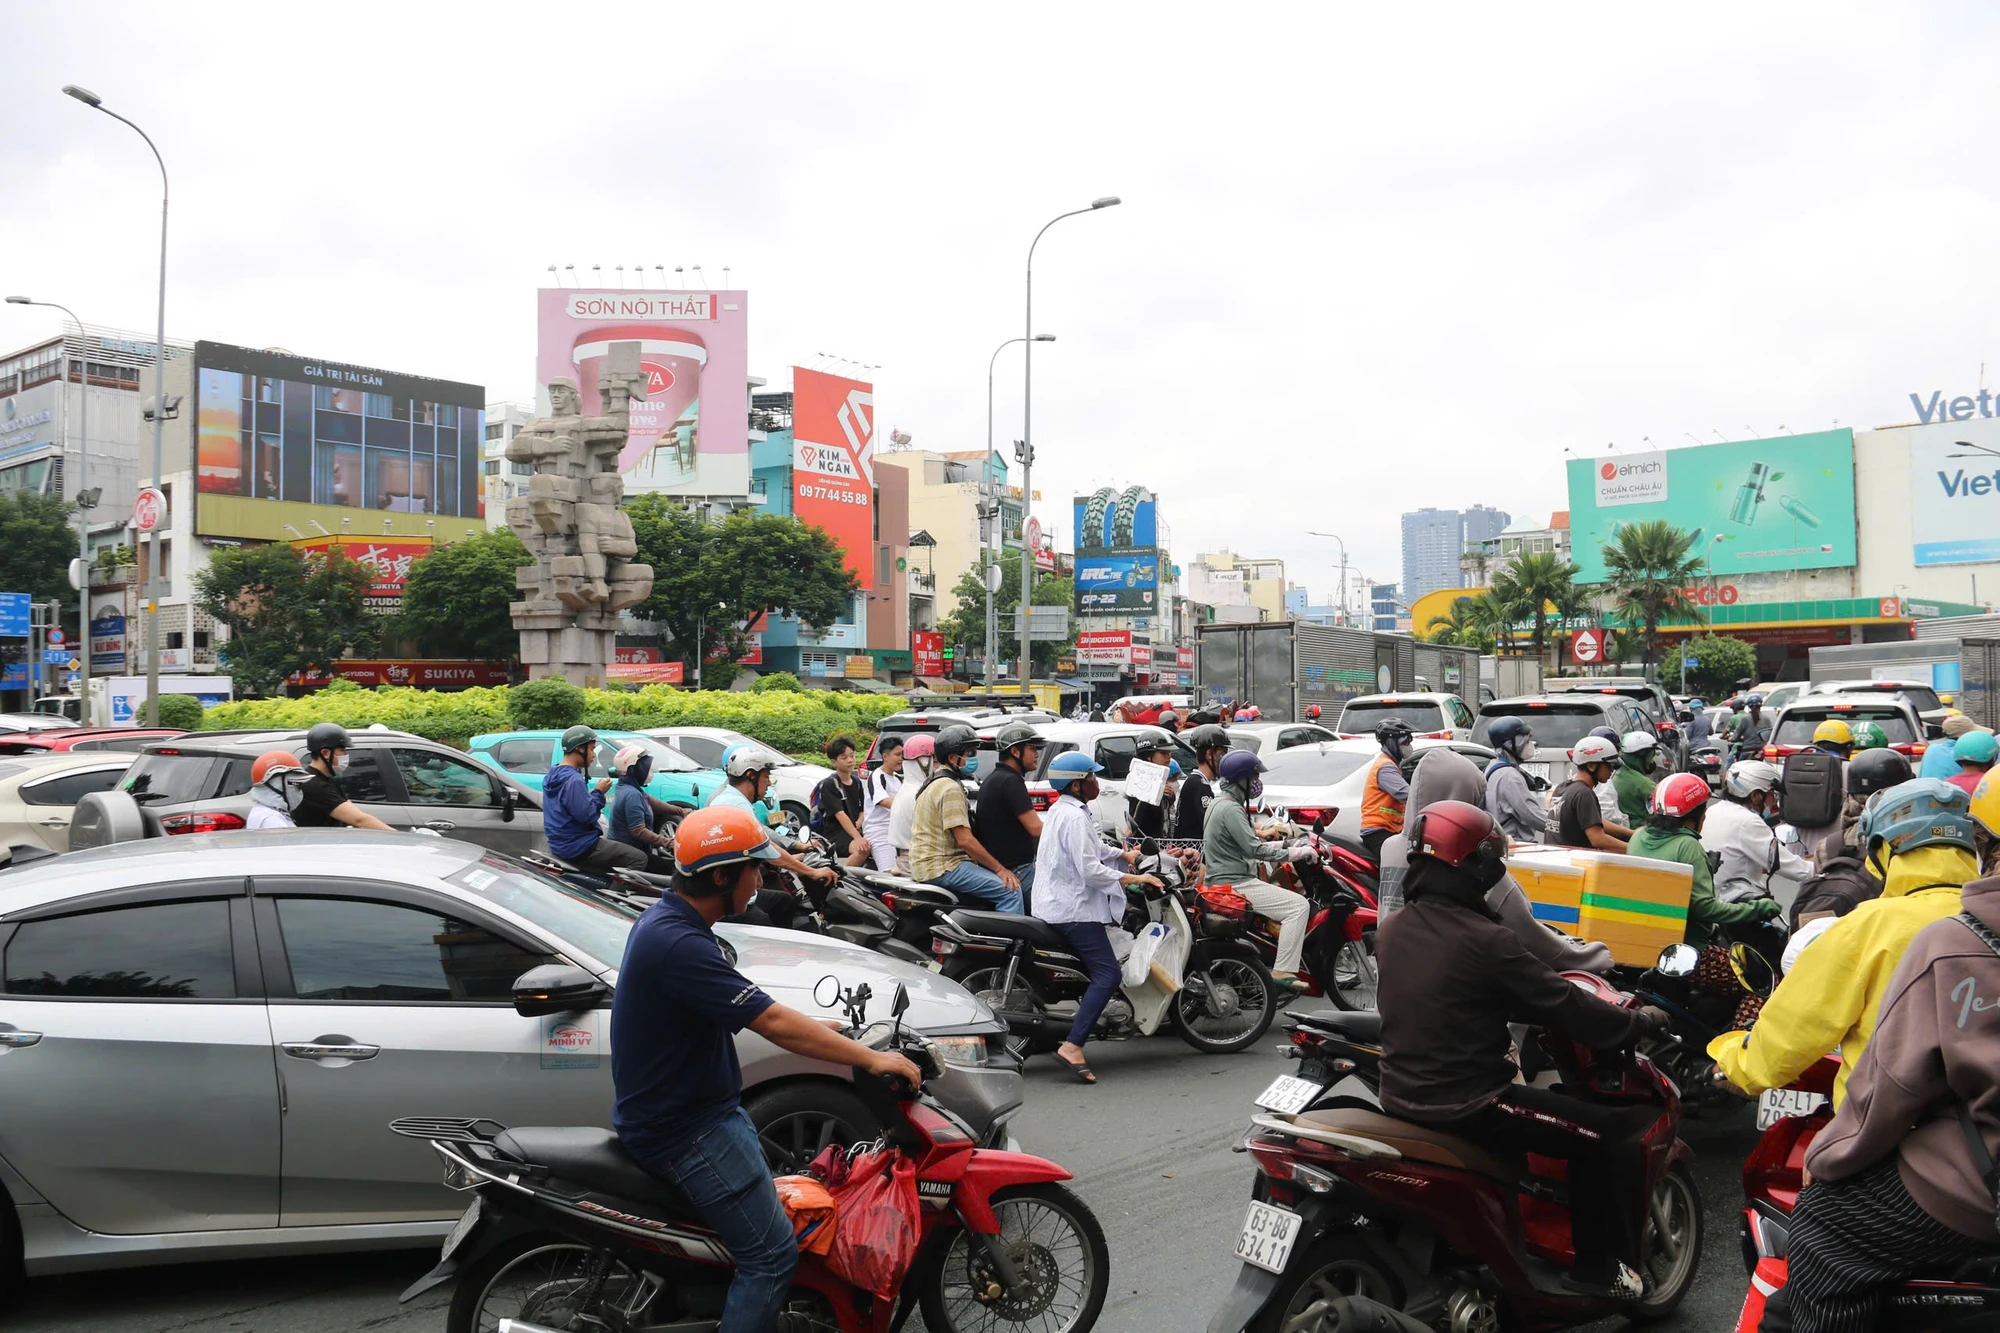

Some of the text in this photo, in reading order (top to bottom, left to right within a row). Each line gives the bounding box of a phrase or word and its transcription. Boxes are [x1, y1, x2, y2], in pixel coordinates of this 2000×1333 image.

[575, 295, 707, 318] SƠN NỘI THẤT
[304, 365, 324, 378] GIÁ
[325, 369, 343, 383] TRỊ
[818, 449, 840, 461] KIM
[1619, 461, 1661, 476] elmich
[800, 484, 868, 505] 09 77 44 55 88
[1080, 567, 1112, 581] IRC
[1081, 593, 1117, 605] GP-22
[1080, 636, 1126, 644] BRIDGESTONE
[424, 668, 476, 679] SUKIYA
[700, 834, 734, 847] Ahamove
[549, 1038, 592, 1046] MINH VY
[1276, 1078, 1315, 1098] 69-L1
[1260, 1090, 1306, 1112] 124.57
[1769, 1089, 1812, 1111] 62-L1
[1762, 1108, 1792, 1126] 79
[920, 1181, 951, 1195] YAMAHA
[1250, 1208, 1291, 1241] 63-B8
[1236, 1231, 1287, 1269] 634.11
